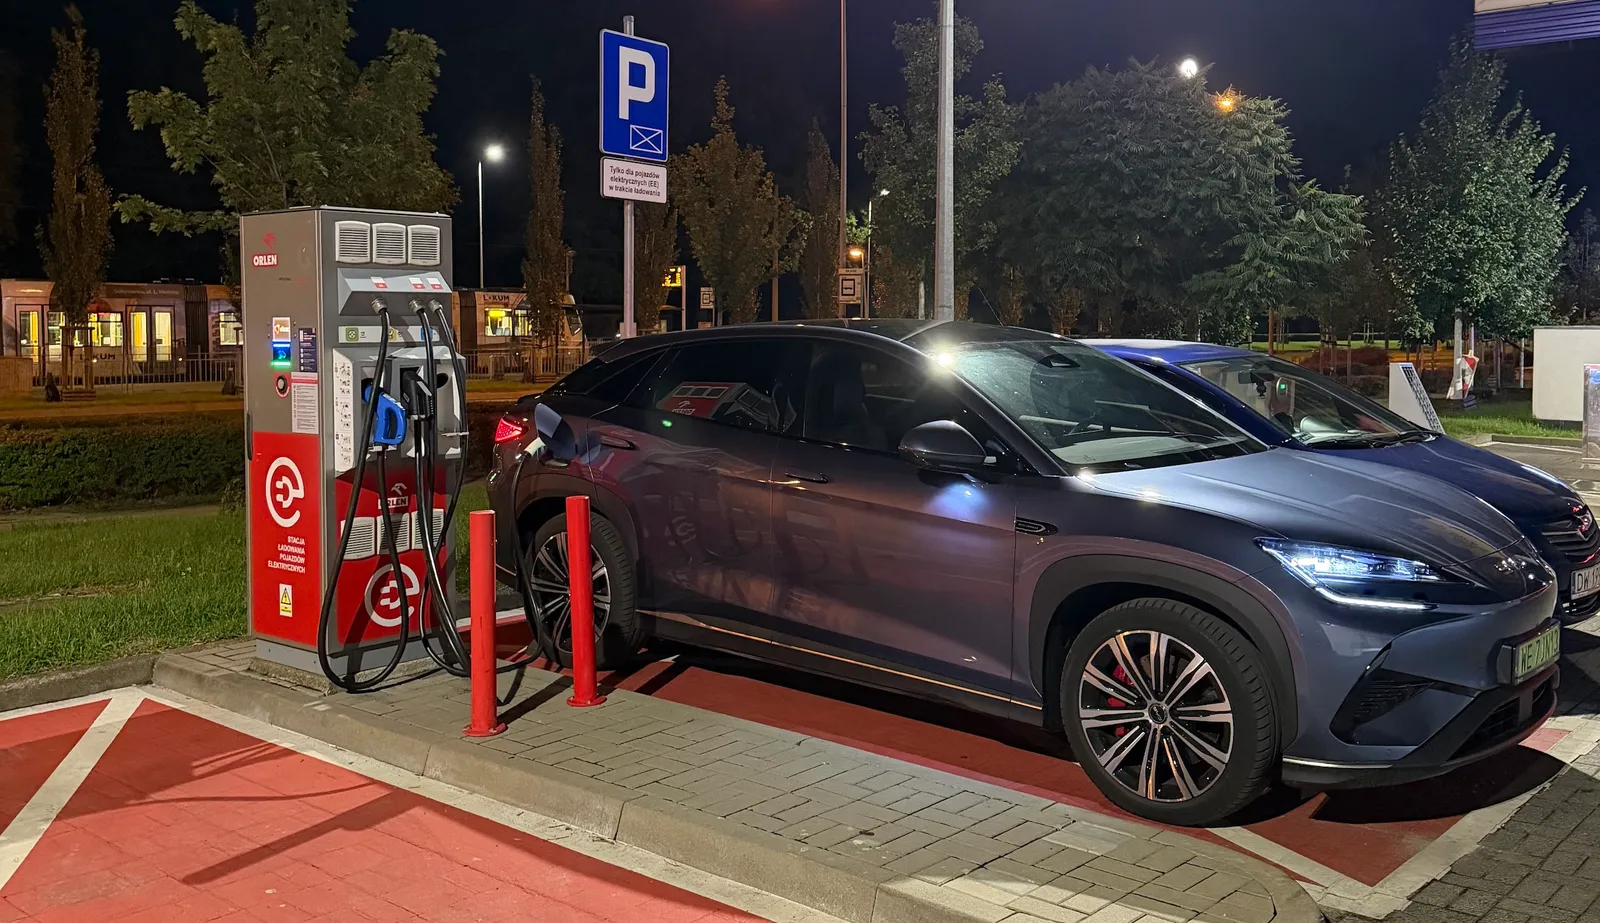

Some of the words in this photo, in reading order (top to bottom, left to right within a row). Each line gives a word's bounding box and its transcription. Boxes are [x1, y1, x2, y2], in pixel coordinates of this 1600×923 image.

[618, 45, 656, 120] P
[610, 166, 624, 174] Tylko
[635, 171, 660, 179] pojazdów
[610, 176, 647, 187] elektrycznych
[648, 180, 660, 189] (EE)
[614, 185, 633, 193] trakcie
[634, 188, 660, 196] ładowania
[253, 254, 278, 266] ORLEN
[287, 535, 306, 546] STACJA
[277, 543, 306, 555] ŁADOWANIA
[279, 553, 306, 564] POJAZDÓW
[267, 560, 306, 574] ELEKTRYCZNYCH
[1577, 572, 1590, 591] DW
[1520, 644, 1532, 674] WE
